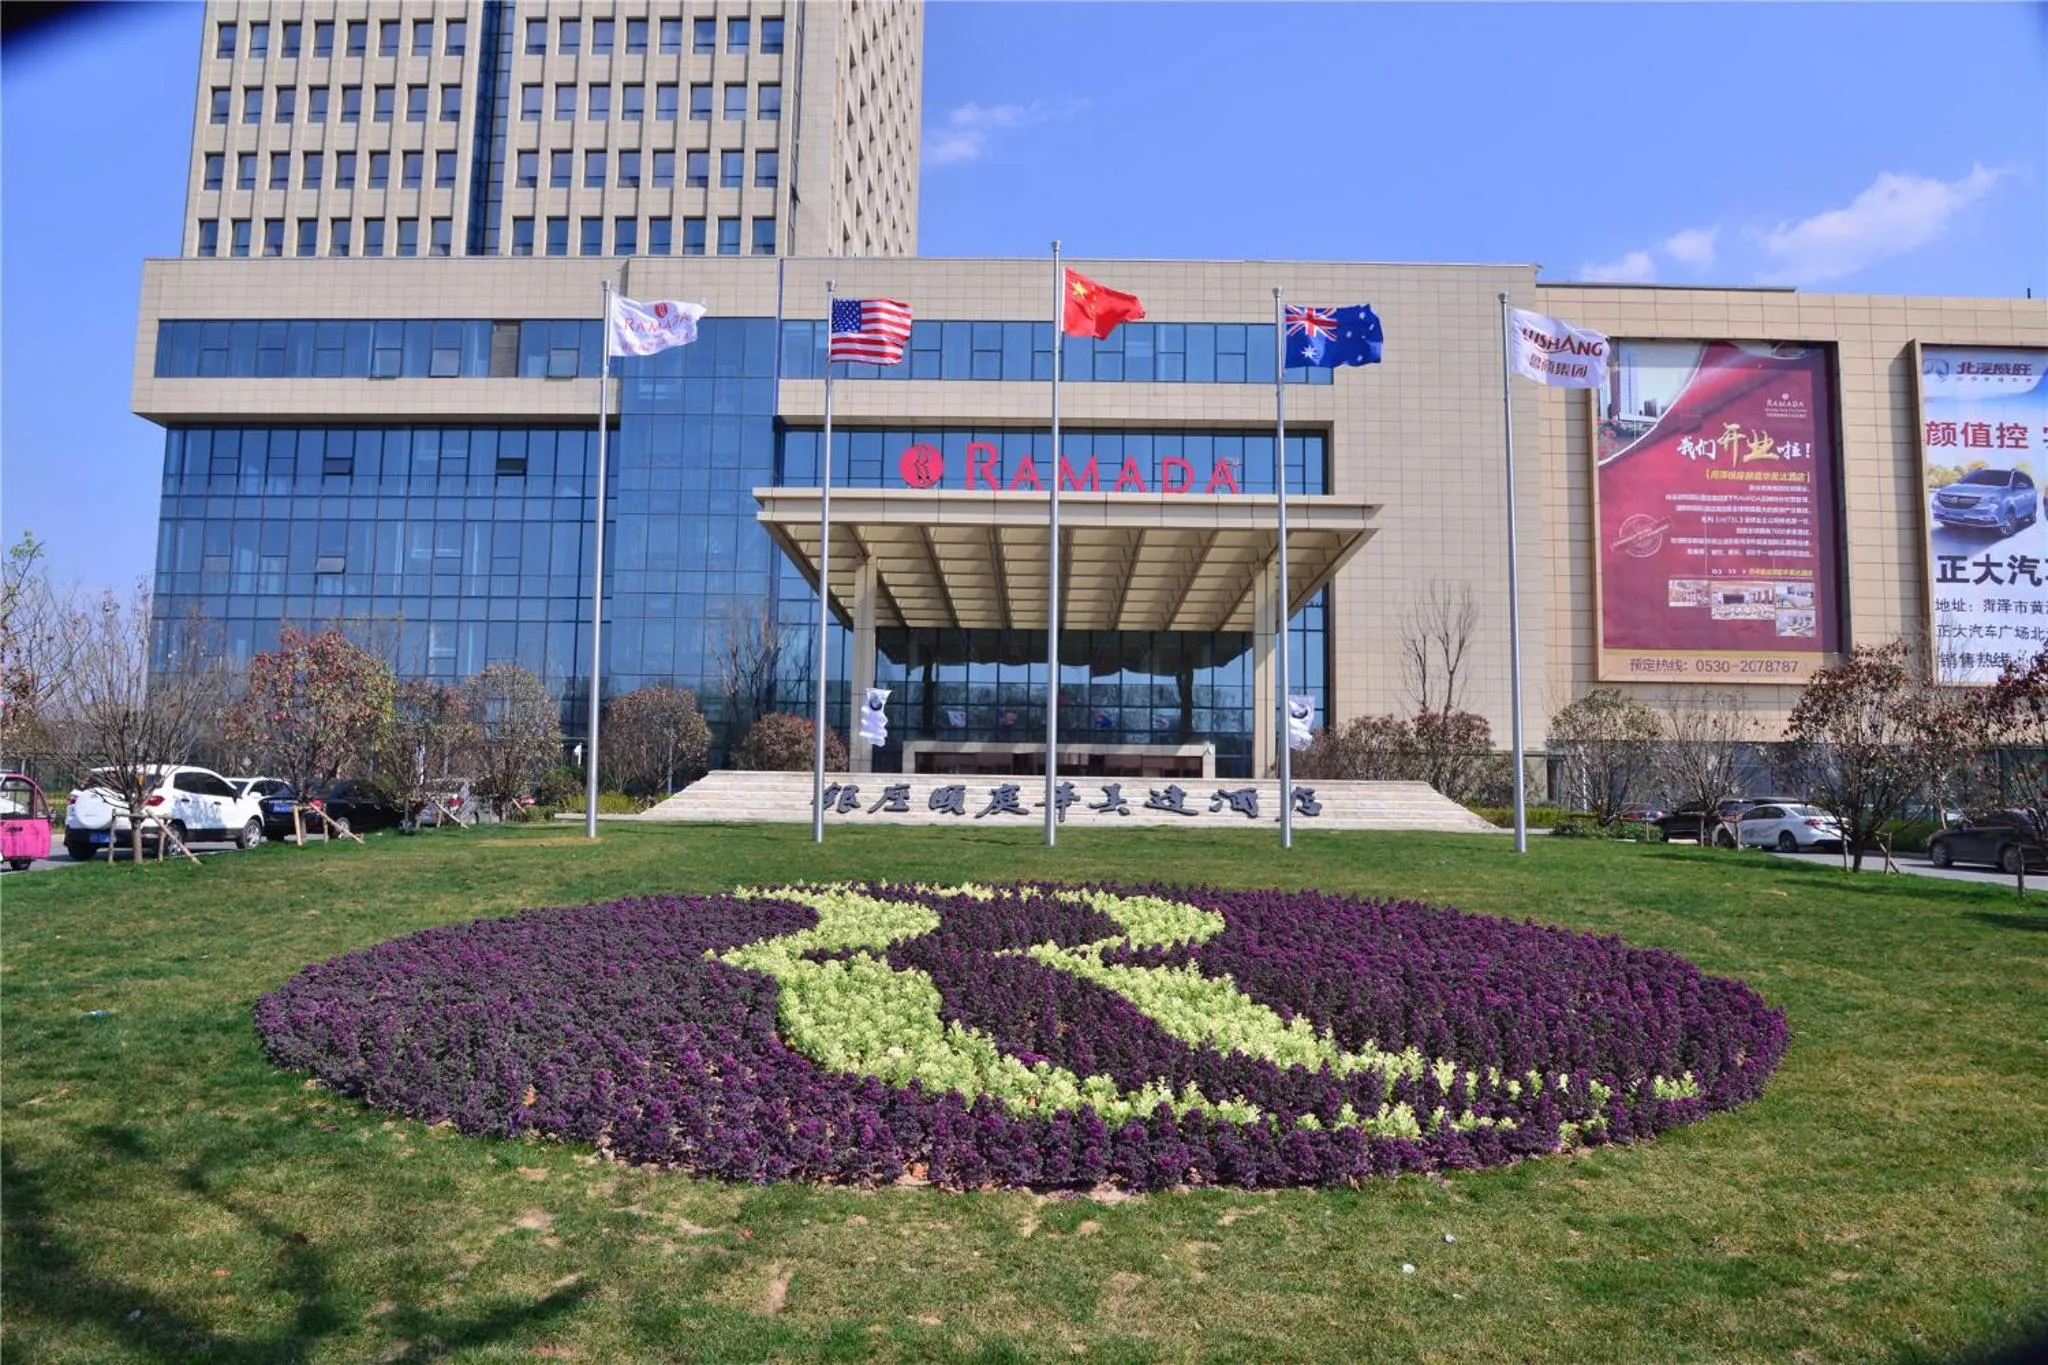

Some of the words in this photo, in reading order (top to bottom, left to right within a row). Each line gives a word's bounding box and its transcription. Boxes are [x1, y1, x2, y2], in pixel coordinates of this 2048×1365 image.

[624, 311, 692, 334] RAMADA
[1956, 361, 2032, 376] 北汽威旺
[1925, 421, 2029, 449] 颜值控
[965, 441, 1239, 494] RAMADA
[1936, 553, 2048, 587] 正大汽
